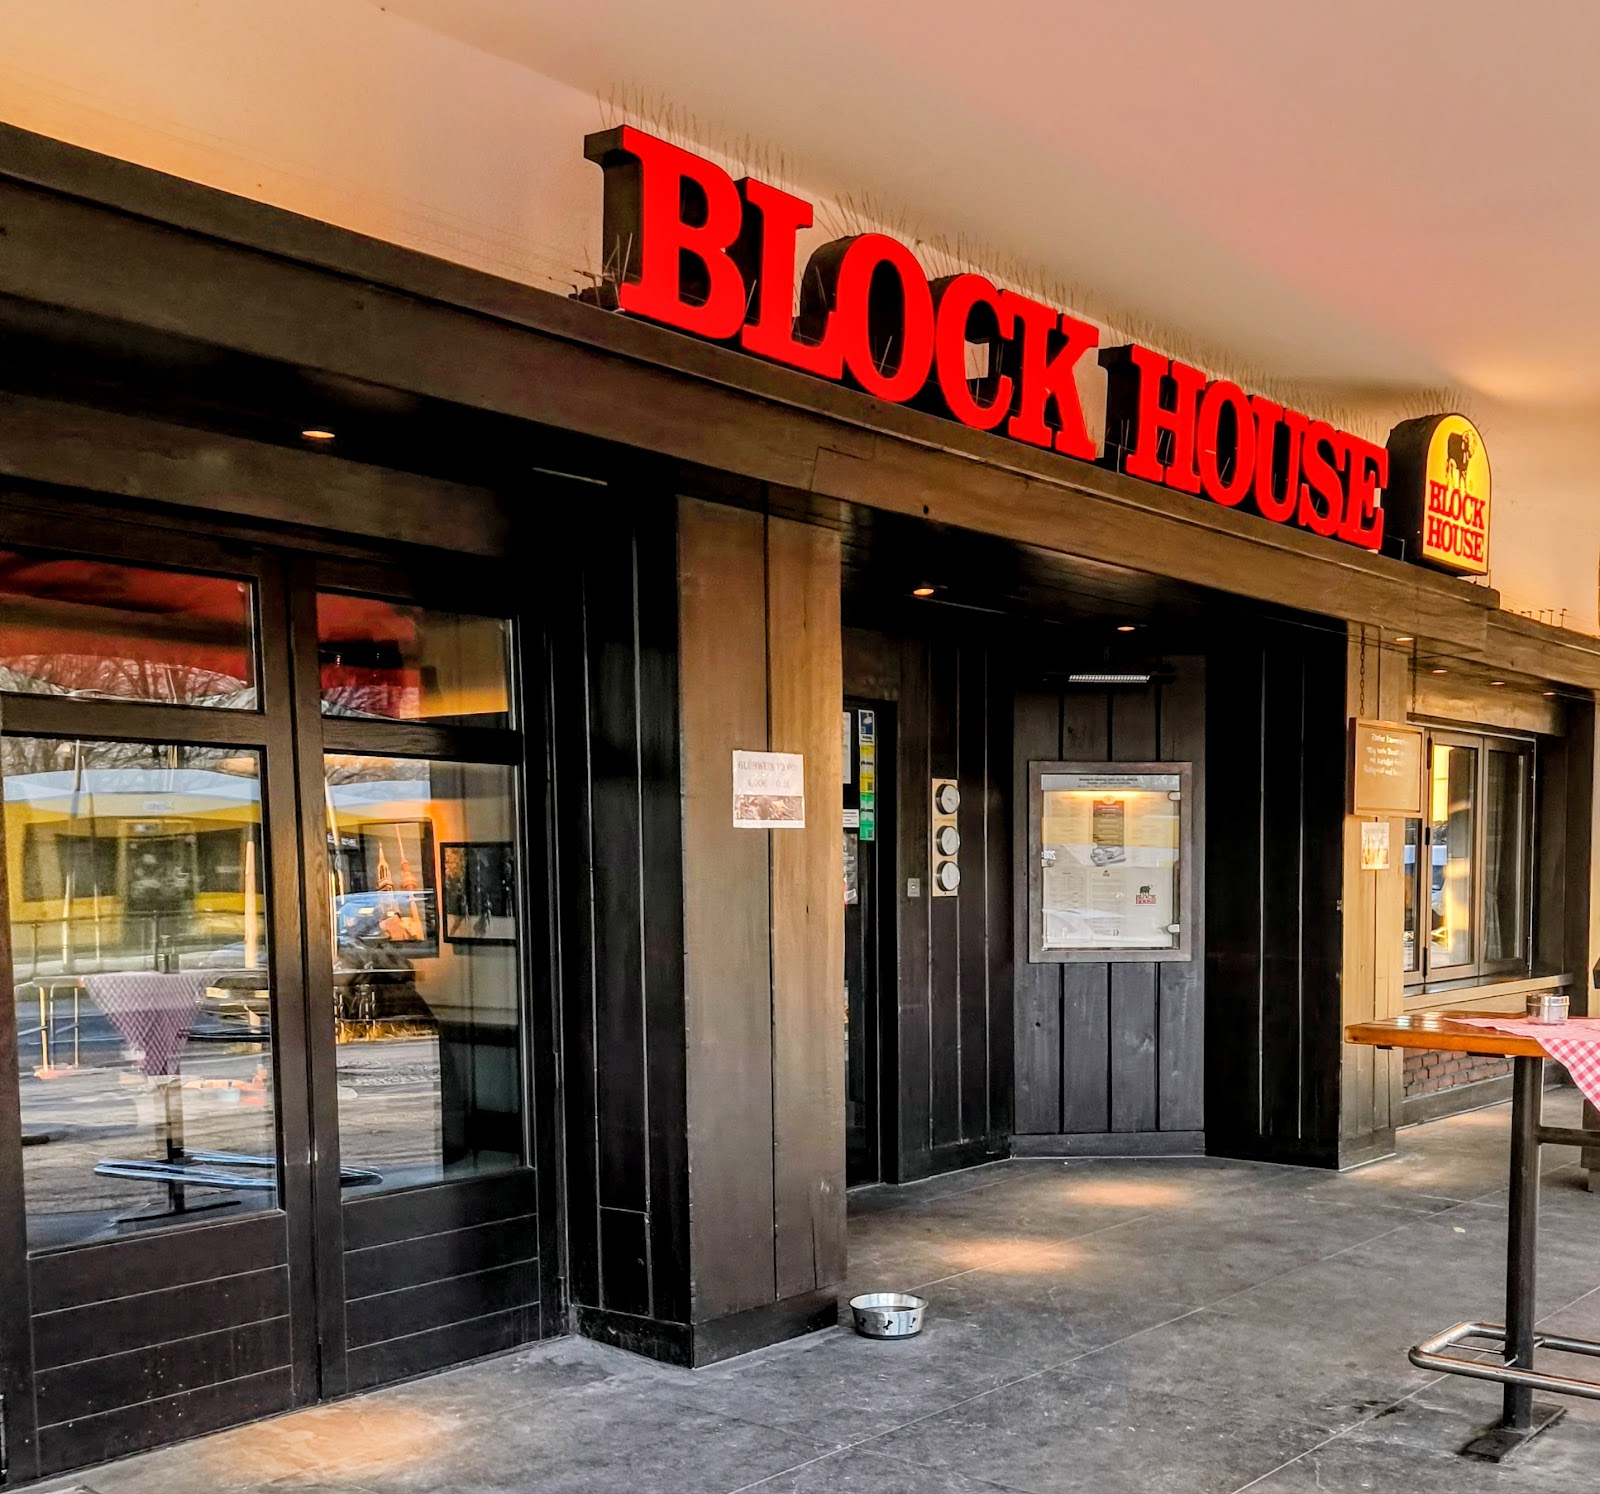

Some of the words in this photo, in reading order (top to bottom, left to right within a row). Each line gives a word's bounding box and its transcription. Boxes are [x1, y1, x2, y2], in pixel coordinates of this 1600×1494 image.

[618, 125, 1100, 461] BLOCK
[1126, 344, 1389, 551] HOUSE
[1428, 480, 1486, 530] BLOCK
[1426, 515, 1485, 563] HOUSE
